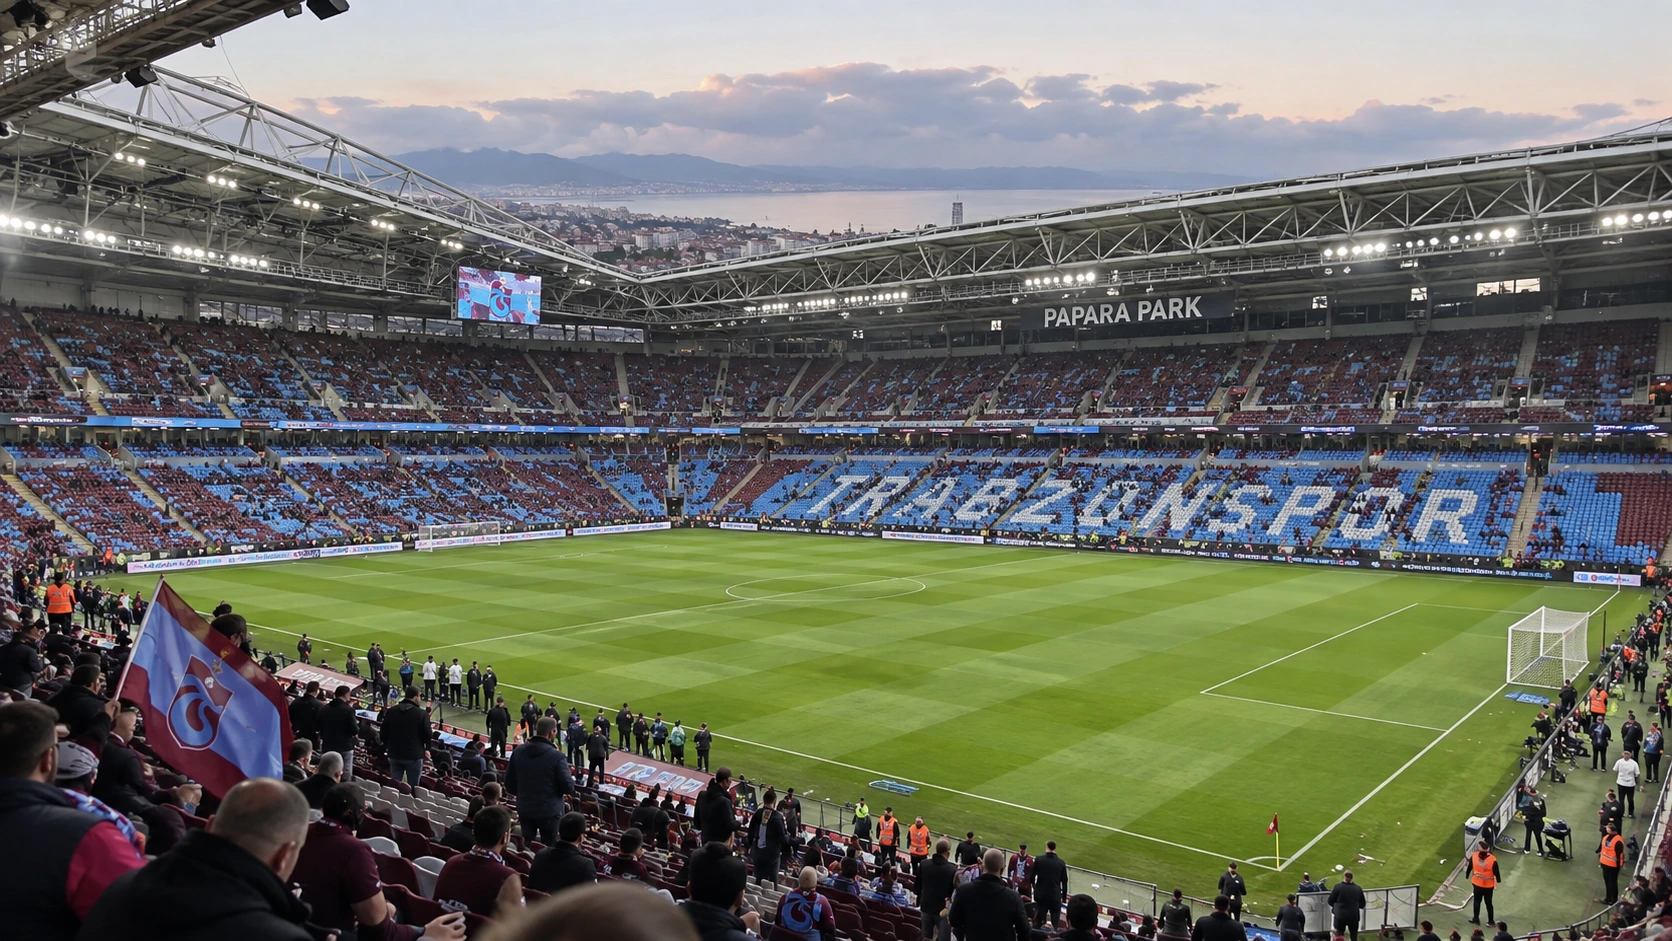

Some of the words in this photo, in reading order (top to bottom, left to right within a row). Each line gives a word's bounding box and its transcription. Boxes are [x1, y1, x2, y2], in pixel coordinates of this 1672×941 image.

[1044, 303, 1131, 328] PAPARA
[1138, 296, 1203, 321] PARK
[806, 475, 1478, 544] TRABZONSPOR
